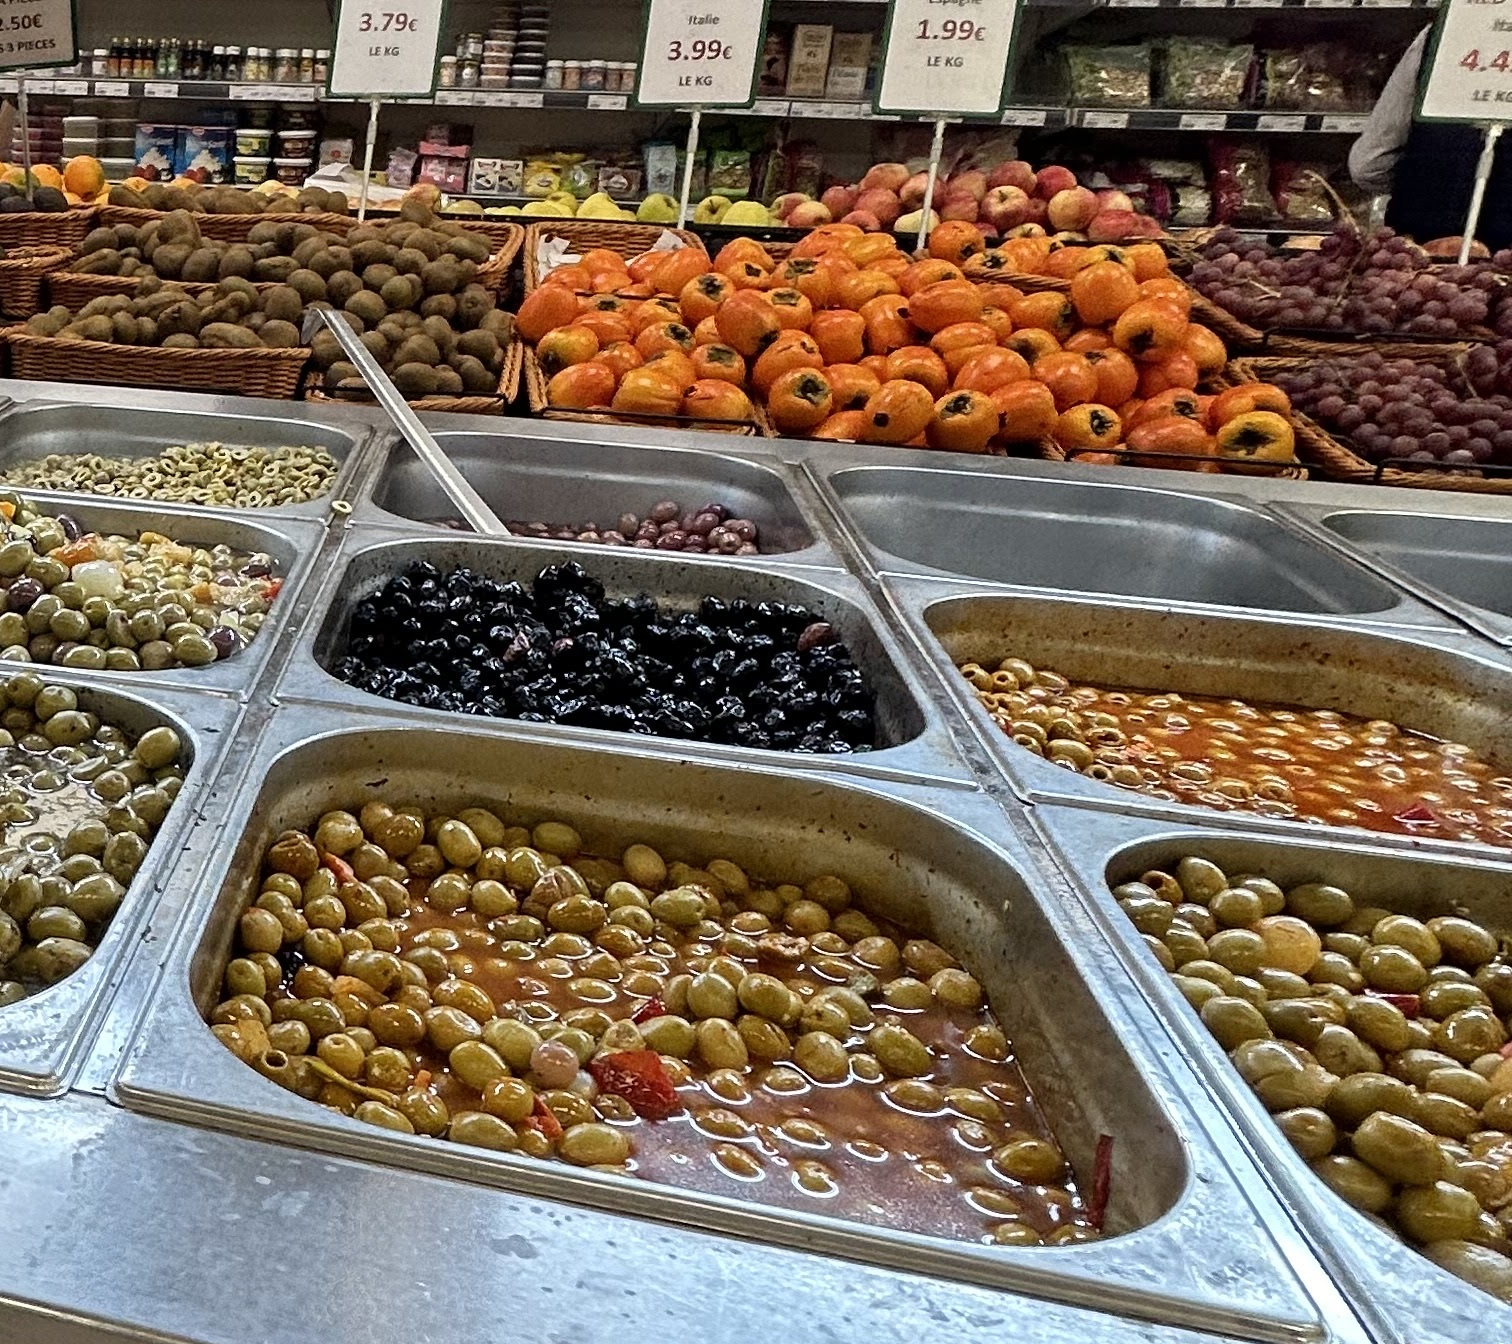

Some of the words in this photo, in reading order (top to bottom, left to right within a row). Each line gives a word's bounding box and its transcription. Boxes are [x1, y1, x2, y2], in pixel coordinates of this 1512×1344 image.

[358, 12, 419, 32] 3.79€
[688, 13, 720, 26] Italie
[915, 19, 987, 42] 1.99€
[7, 42, 15, 53] 3
[17, 38, 56, 51] PIECES
[369, 46, 381, 56] LE
[384, 46, 400, 56] KG
[667, 39, 733, 61] 3.99€
[927, 56, 941, 67] LE
[944, 56, 964, 67] KG
[1459, 49, 1512, 72] 4.4
[678, 75, 692, 87] LE
[695, 75, 713, 87] KG
[1472, 89, 1491, 102] LE
